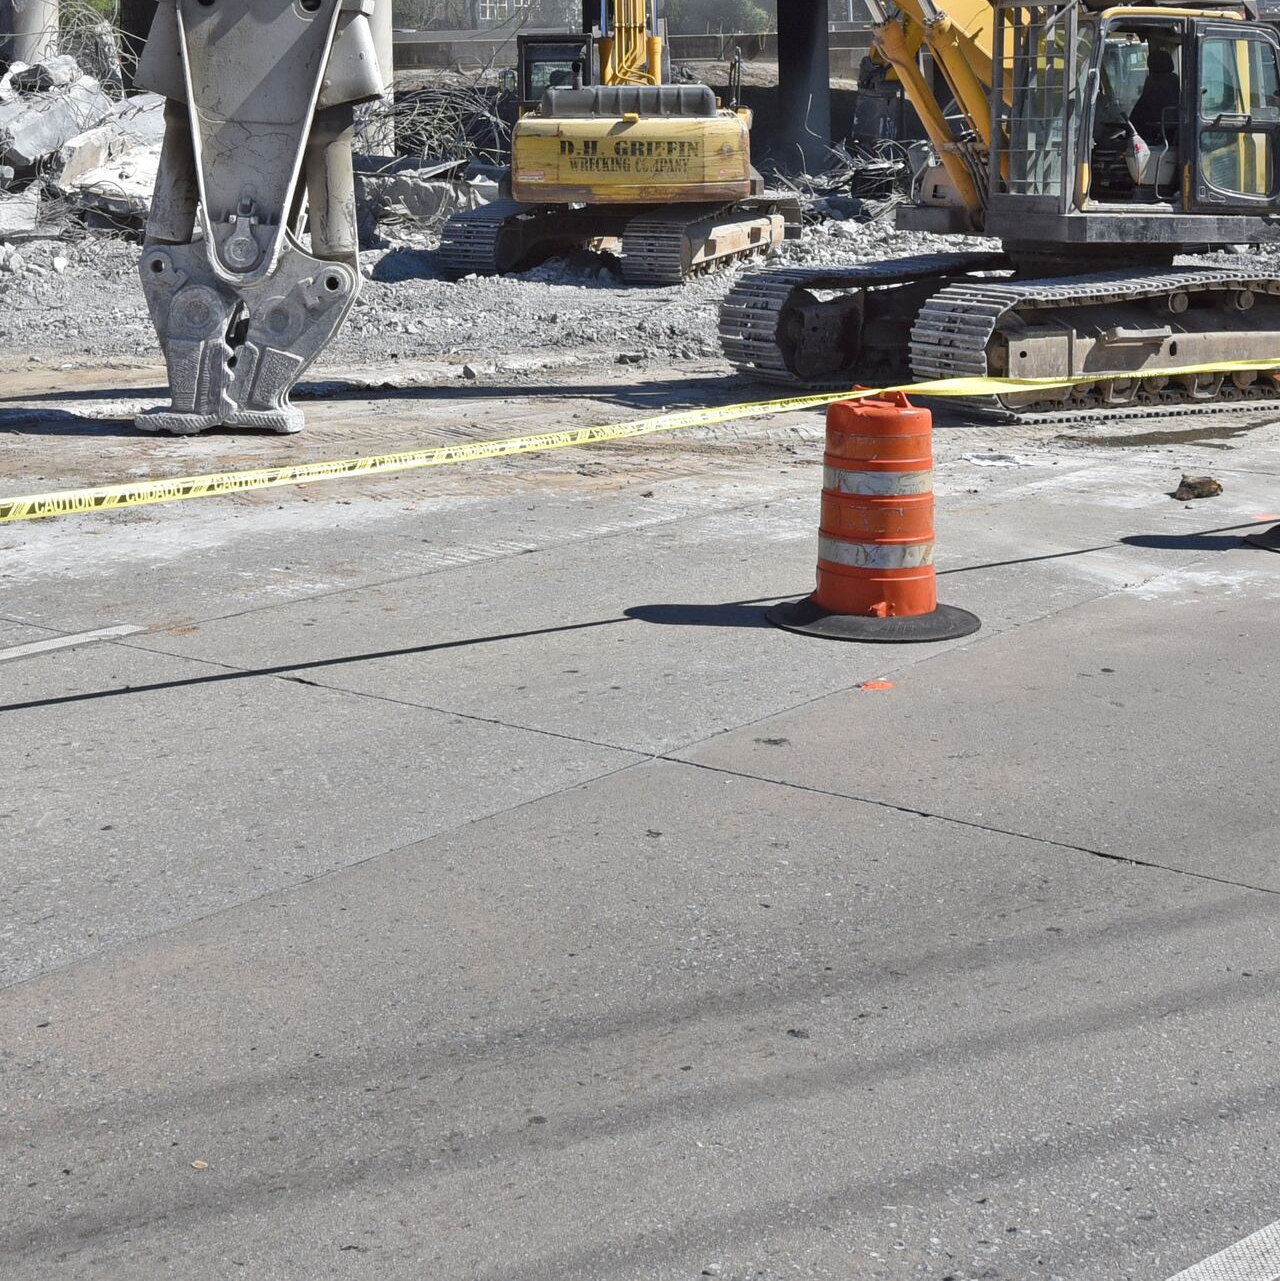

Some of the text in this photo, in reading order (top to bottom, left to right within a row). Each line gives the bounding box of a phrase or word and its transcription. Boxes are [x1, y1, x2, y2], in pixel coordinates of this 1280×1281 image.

[560, 140, 700, 157] D.H. GRIFFIN
[569, 157, 630, 172] WRECKING
[34, 493, 96, 513] CAUTION
[125, 483, 183, 502] CUIDADO
